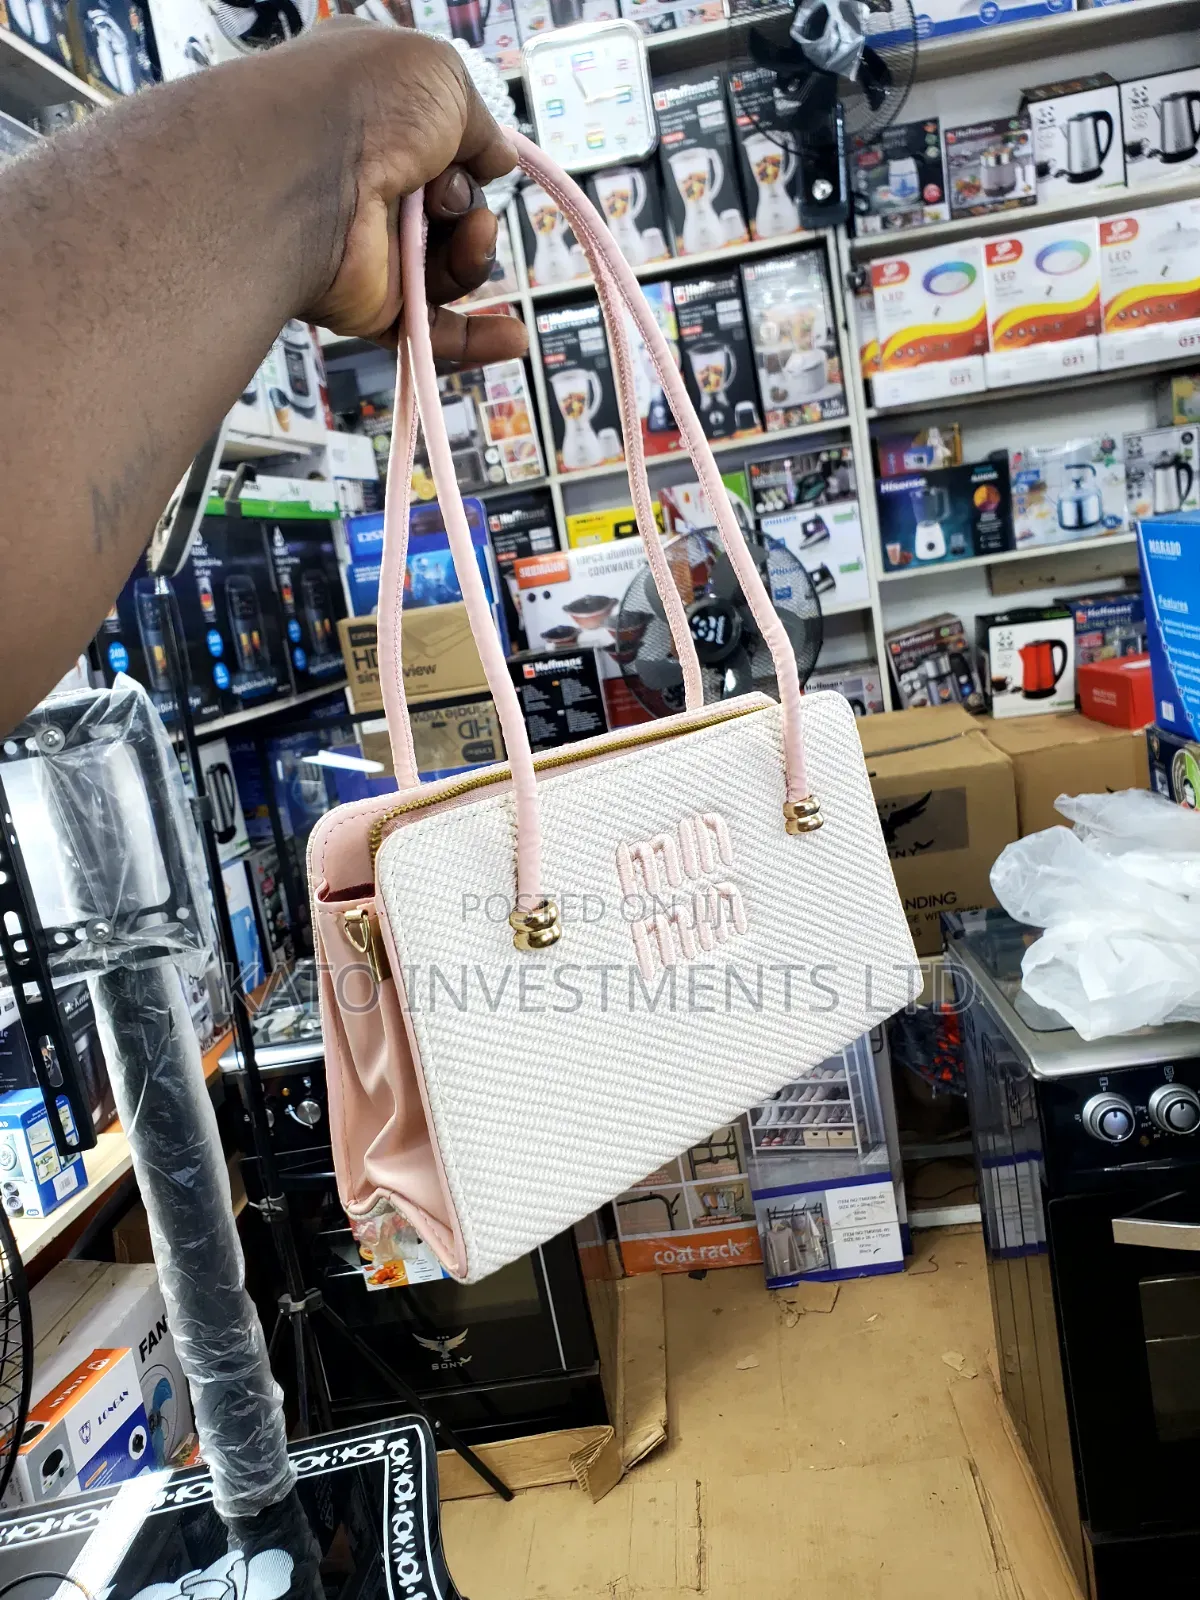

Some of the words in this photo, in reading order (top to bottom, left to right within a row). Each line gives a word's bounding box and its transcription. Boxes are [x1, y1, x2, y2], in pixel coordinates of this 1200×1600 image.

[881, 477, 927, 493] Hisense
[403, 664, 437, 677] view
[535, 656, 583, 672] Hoffmans
[654, 1245, 696, 1265] coat
[700, 1238, 741, 1259] rack
[138, 1314, 168, 1364] FAN
